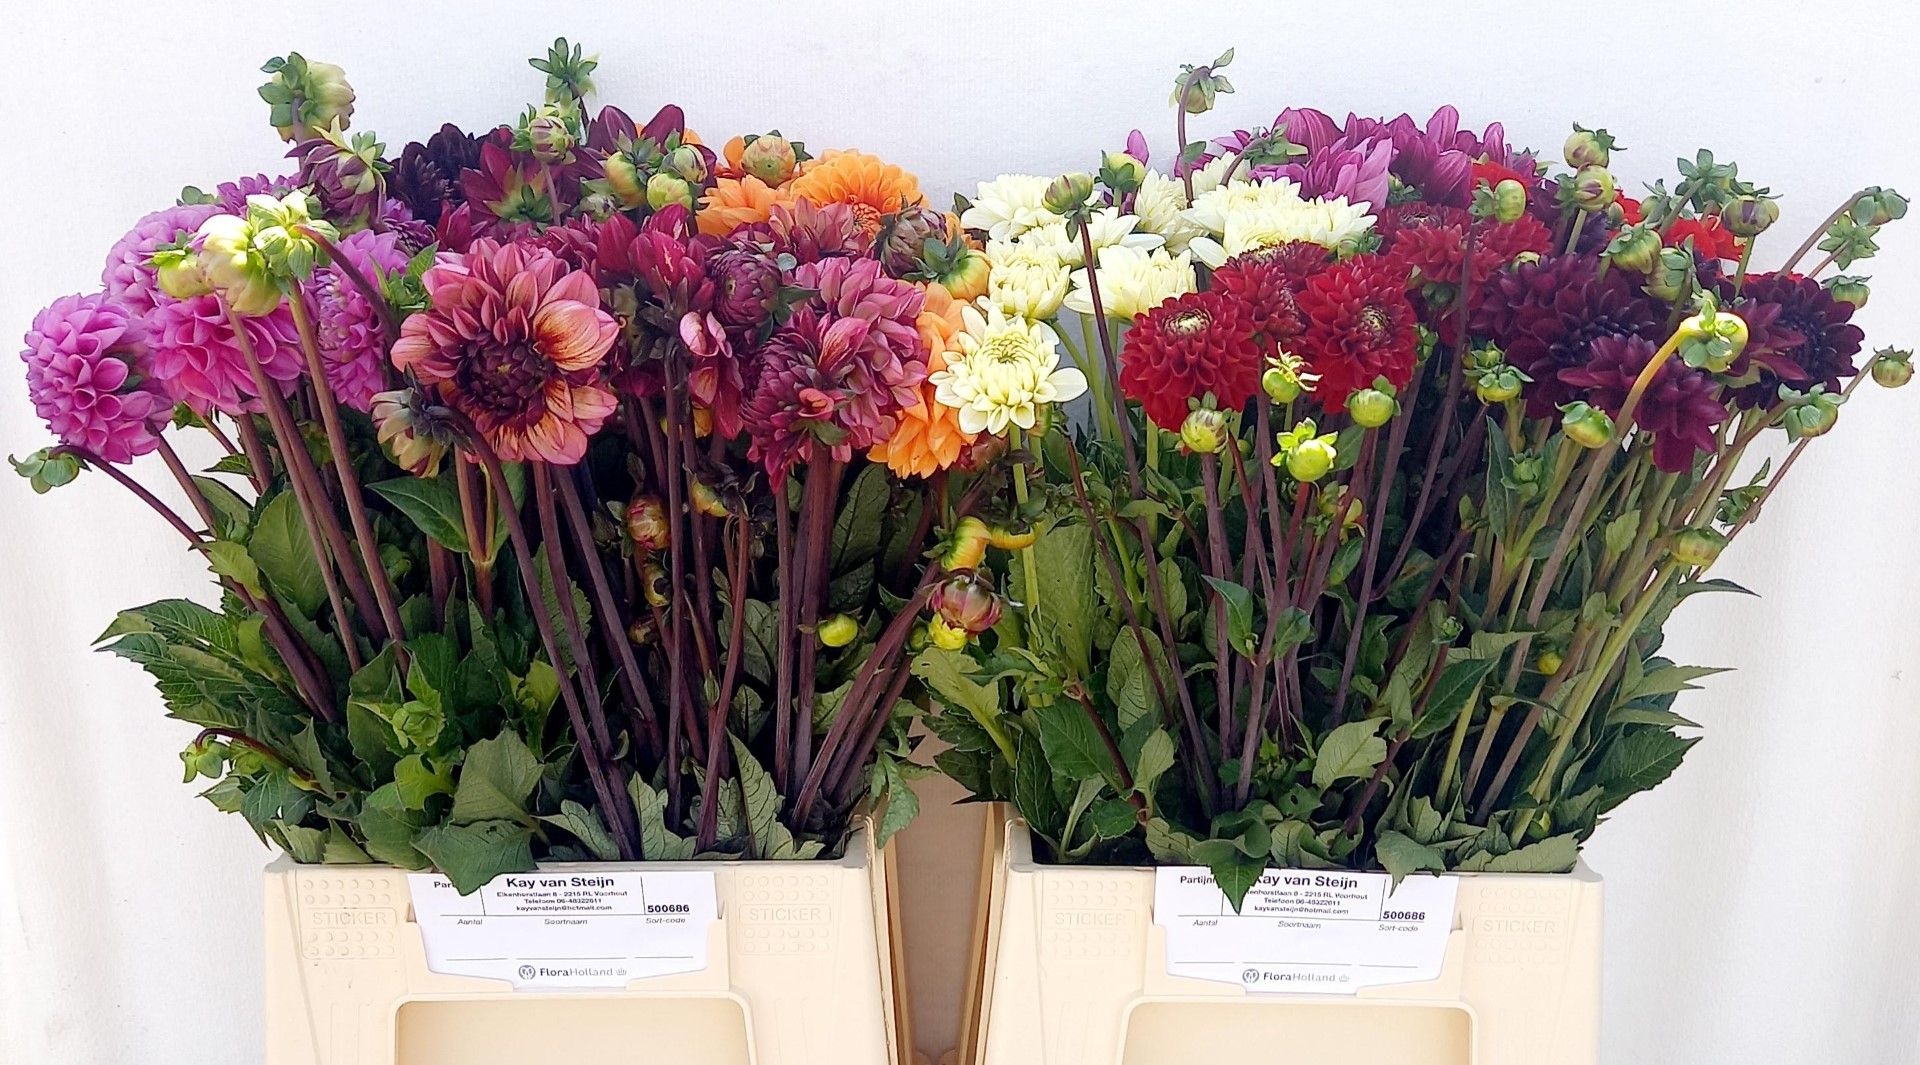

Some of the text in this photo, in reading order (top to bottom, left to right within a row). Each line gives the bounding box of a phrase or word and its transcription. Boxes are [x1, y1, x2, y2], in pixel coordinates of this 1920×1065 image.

[507, 877, 614, 889] Kay van Steijn
[1284, 876, 1311, 886] van
[1316, 876, 1357, 889] Steijn
[647, 905, 690, 914] 500686
[750, 908, 822, 921] STICKER
[313, 912, 386, 925] STICKER
[1055, 912, 1126, 925] STICKER
[1381, 911, 1426, 922] 500686
[1277, 920, 1321, 928] Soortnaam
[1483, 919, 1555, 933] STICKER
[540, 968, 613, 976] FloraHolland
[1264, 972, 1335, 981] FloraHolland
